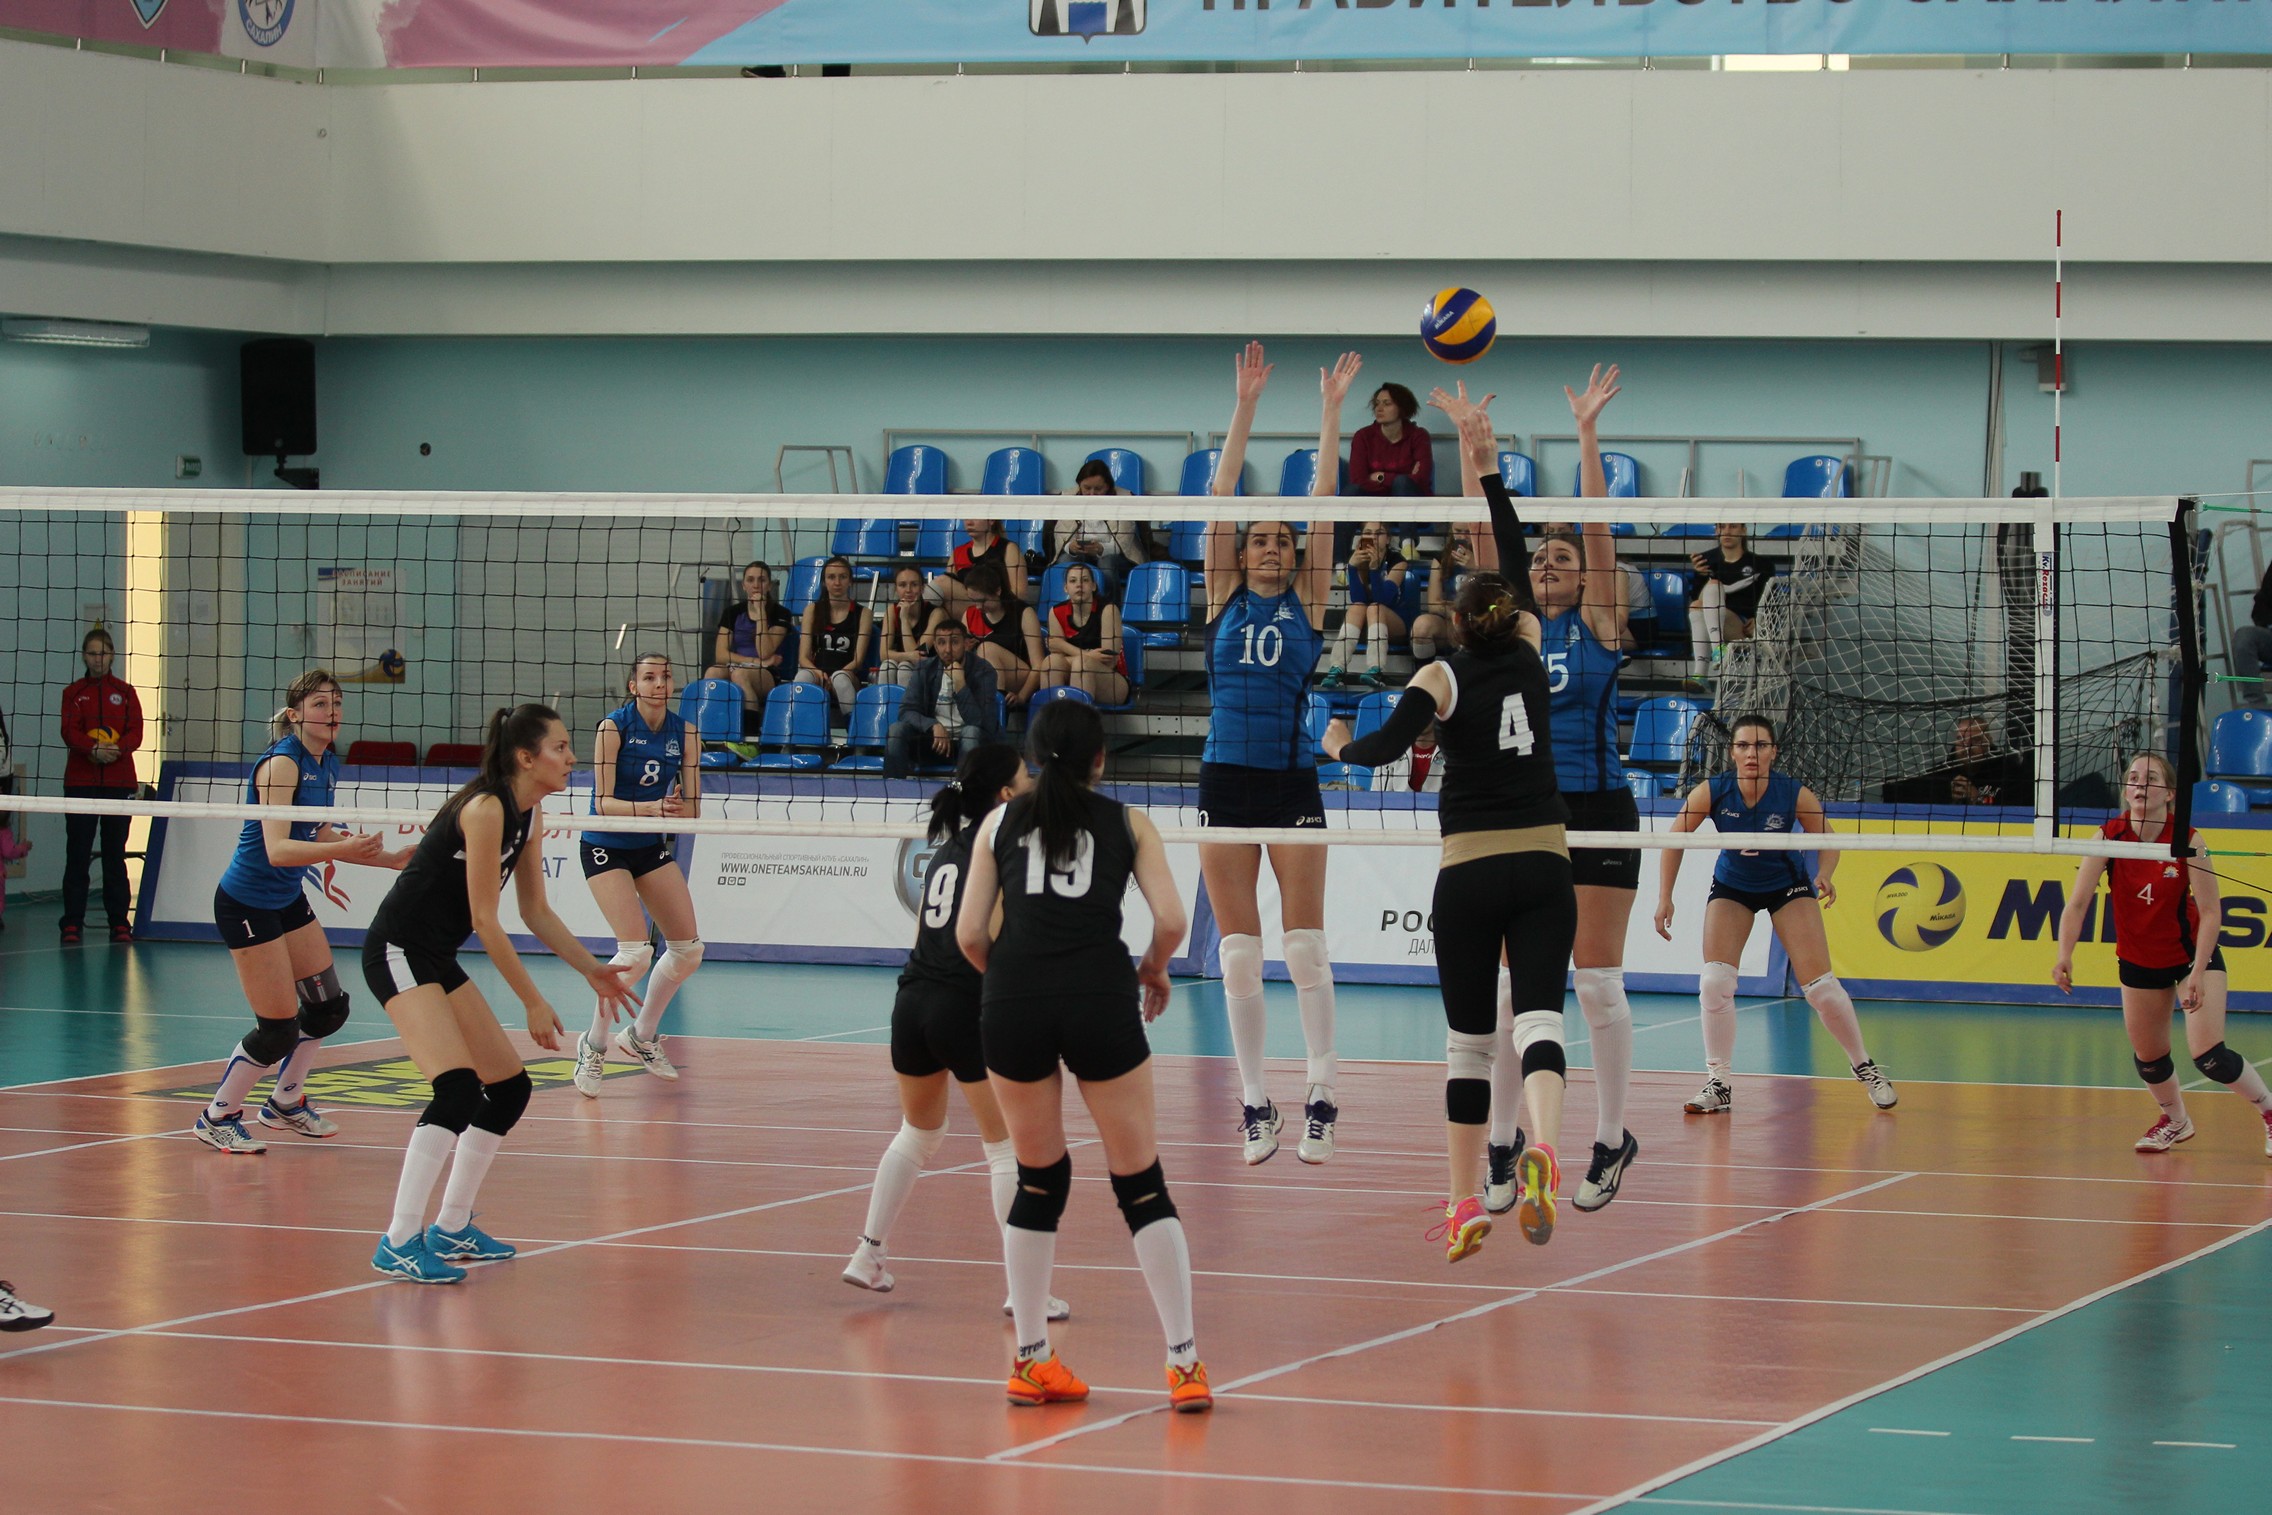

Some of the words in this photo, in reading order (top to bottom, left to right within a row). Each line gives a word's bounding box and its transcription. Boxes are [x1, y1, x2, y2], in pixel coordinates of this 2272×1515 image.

[823, 634, 851, 653] 12
[1239, 623, 1284, 667] 10
[1498, 692, 1535, 756] 4
[639, 759, 661, 787] 8
[591, 847, 609, 866] 8
[1017, 827, 1095, 898] 19
[720, 862, 869, 878] WWW.ONETEAMSAKHALIN.RU
[925, 863, 959, 929] 9
[2136, 882, 2155, 905] 4
[241, 918, 256, 939] 1
[1407, 938, 1436, 956] ДАЛ
